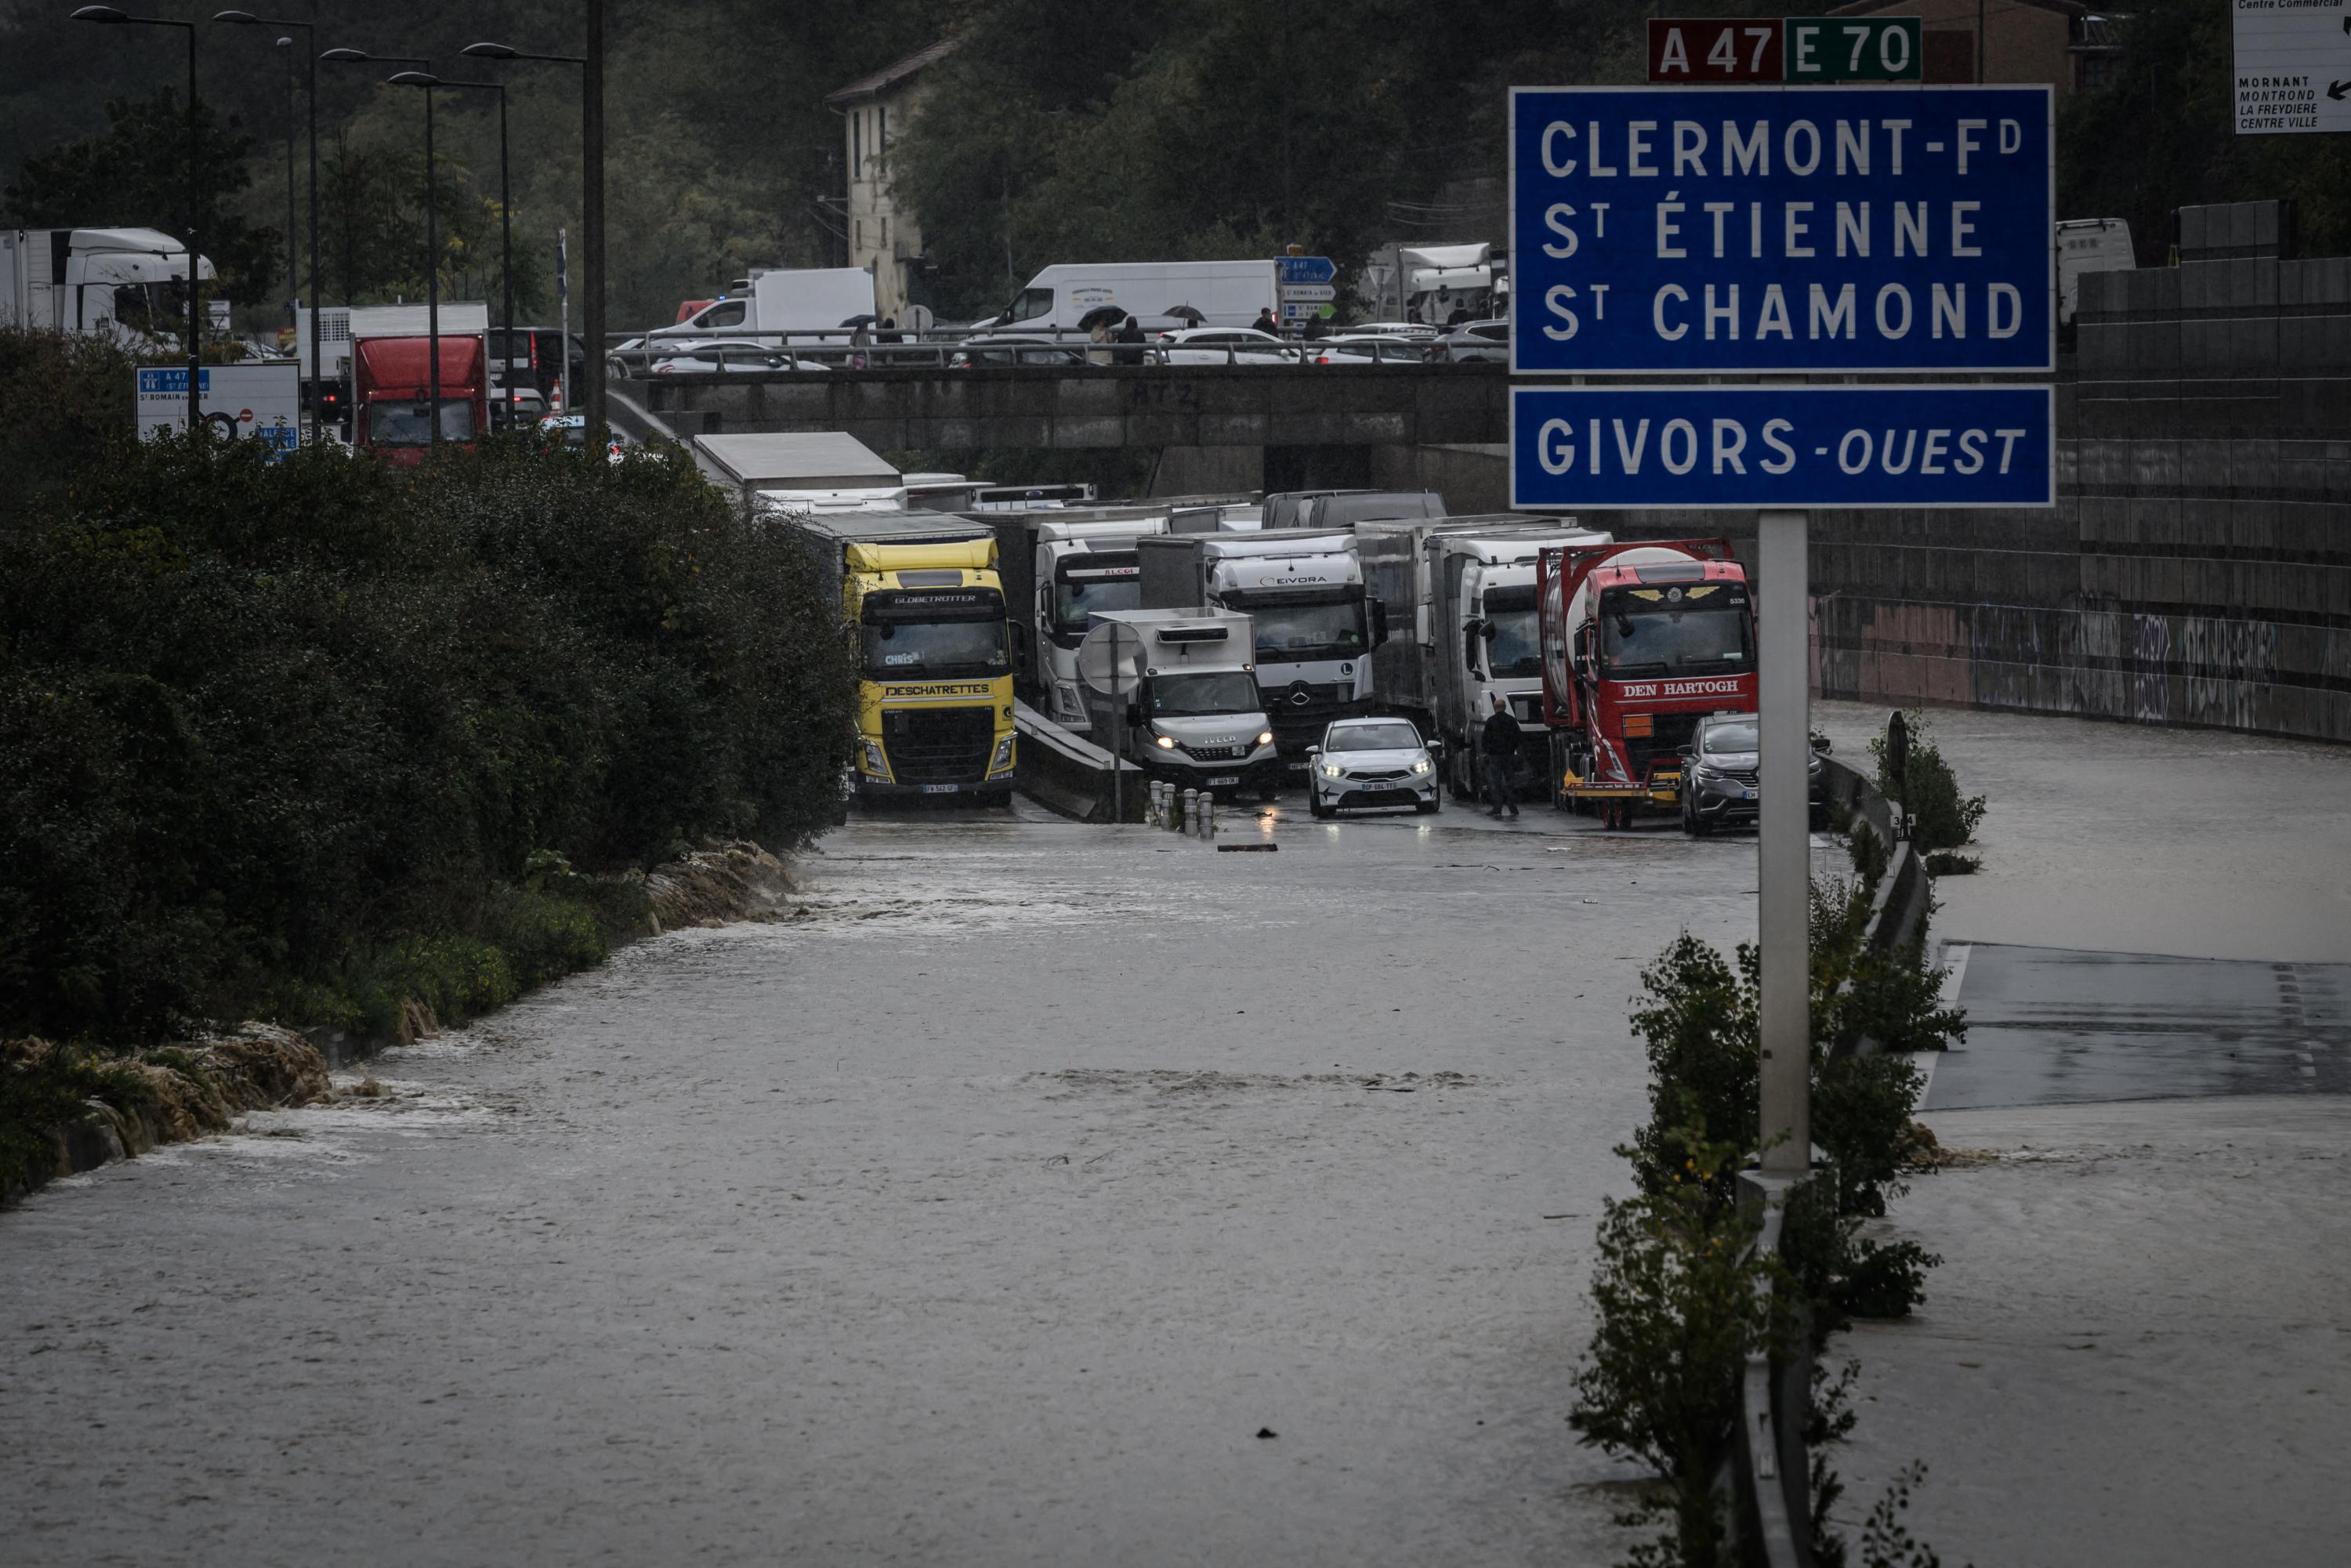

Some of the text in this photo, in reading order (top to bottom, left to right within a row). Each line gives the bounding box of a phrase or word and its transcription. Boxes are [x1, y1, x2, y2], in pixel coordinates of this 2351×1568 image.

[2238, 0, 2274, 9] Centre
[1659, 27, 1773, 73] A 47
[1797, 25, 1910, 72] E 70
[2239, 76, 2309, 88] MORNANT
[2240, 90, 2315, 101] MONTROND
[2240, 103, 2317, 115] LA FREYDIERE
[2241, 117, 2317, 129] CENTRE VILLE
[1541, 190, 1982, 259] ST ÉTIENNE
[1542, 282, 2023, 341] ST CHAMOND
[175, 372, 187, 381] 47
[895, 595, 976, 604] GLOBETROTTER
[886, 684, 989, 696] DESCHATRETTES
[1624, 680, 1739, 697] DEN HARTOGH
[1204, 735, 1236, 744] IVECO
